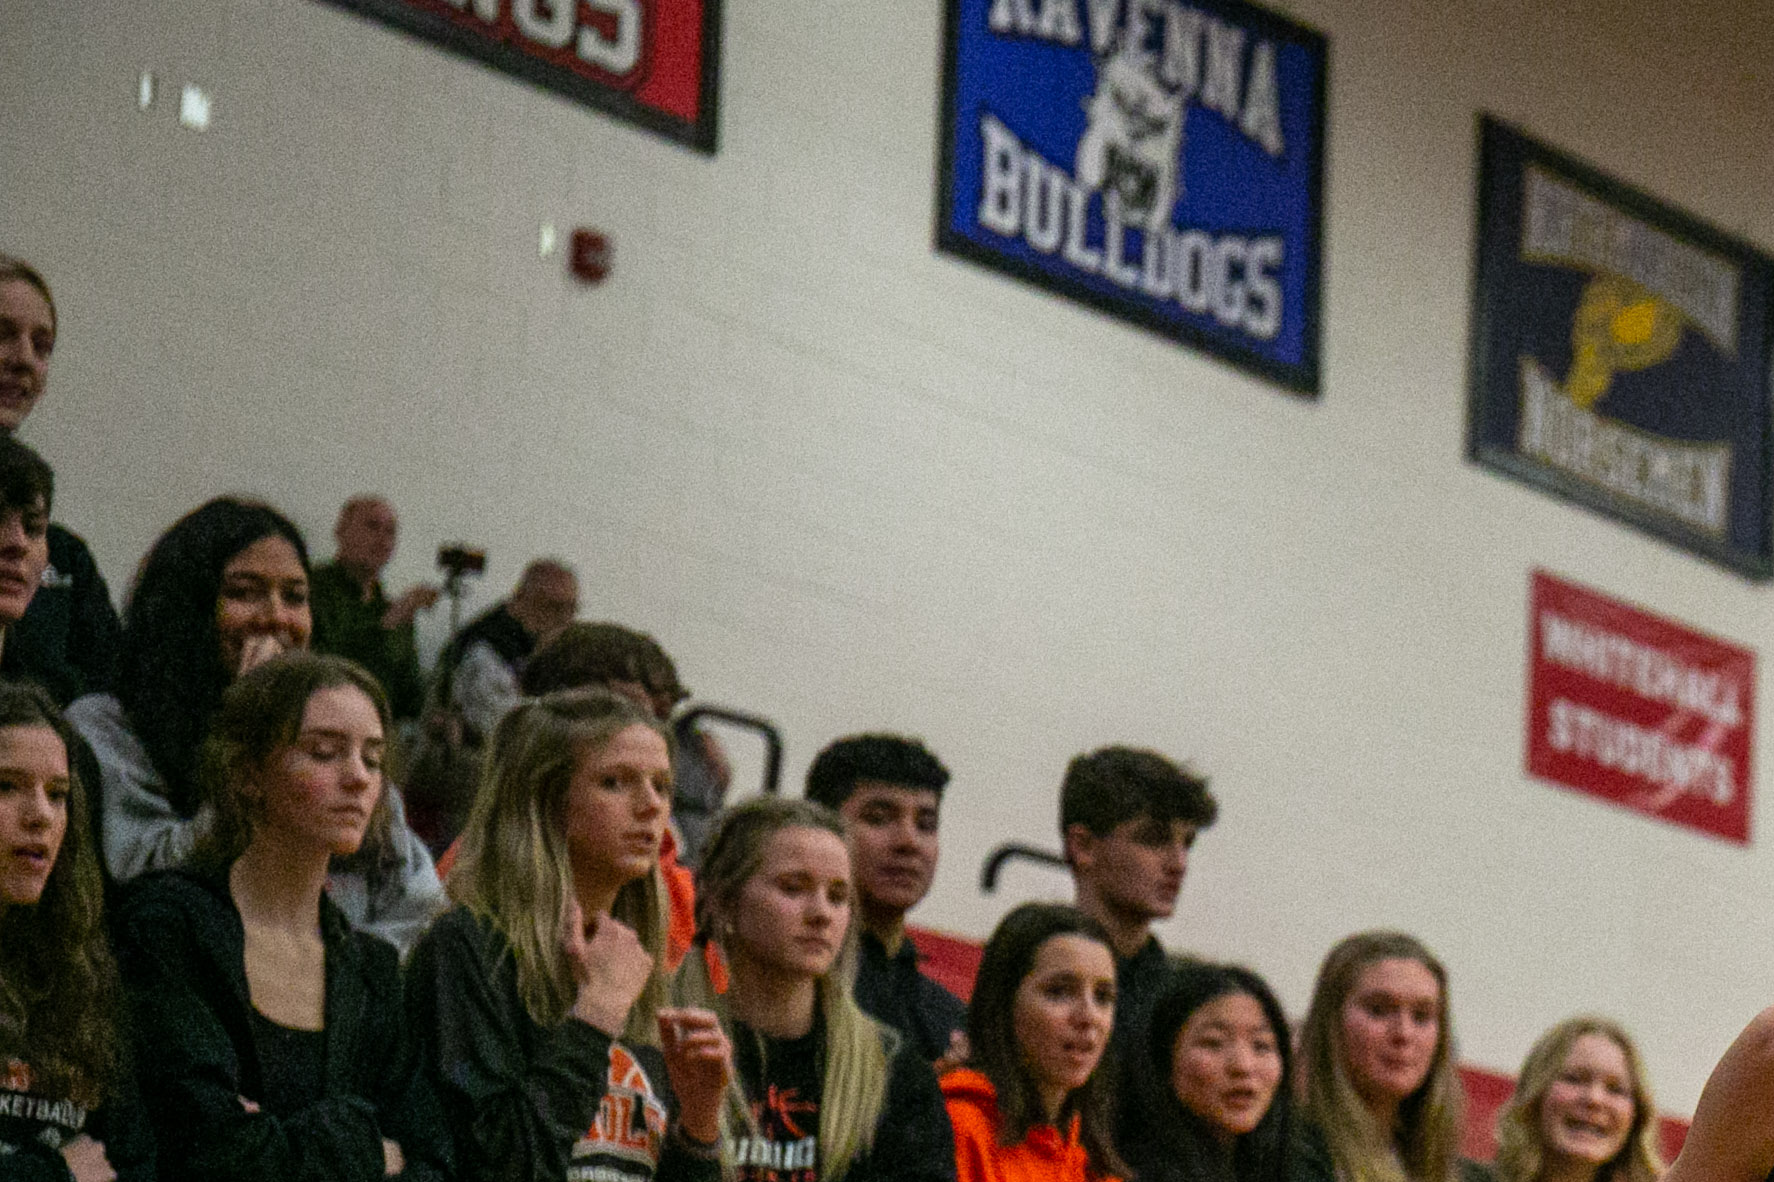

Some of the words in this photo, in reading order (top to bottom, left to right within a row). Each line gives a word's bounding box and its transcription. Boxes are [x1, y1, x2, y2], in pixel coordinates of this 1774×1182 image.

[977, 112, 1285, 340] BULLDOGS
[1541, 610, 1741, 726] WHITEHALL
[1548, 696, 1735, 806] STUDENTS
